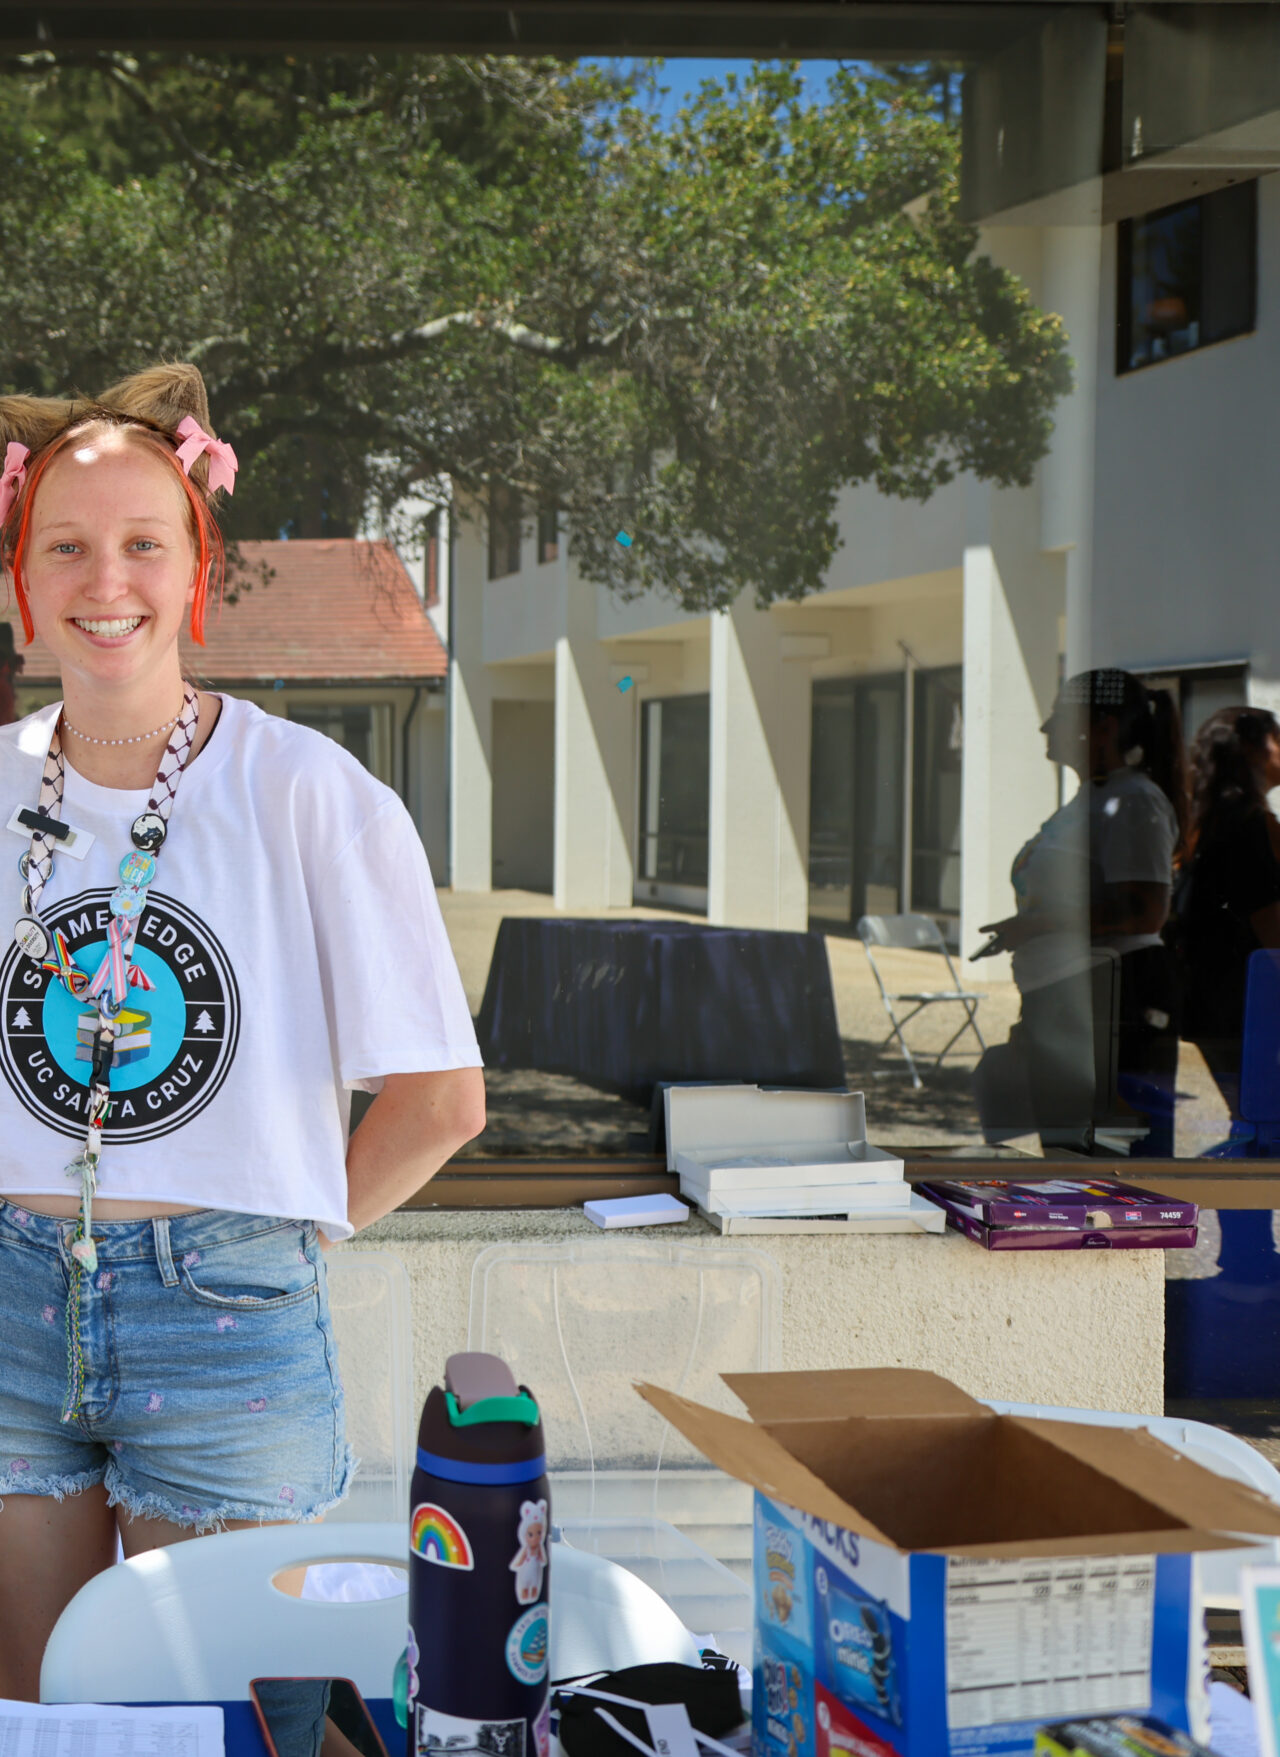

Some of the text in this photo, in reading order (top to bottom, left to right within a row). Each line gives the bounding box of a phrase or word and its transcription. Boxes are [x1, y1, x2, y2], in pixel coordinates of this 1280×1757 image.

[142, 915, 207, 983] EDGE
[28, 1050, 54, 1083] UC
[147, 1053, 203, 1109] CRUZ
